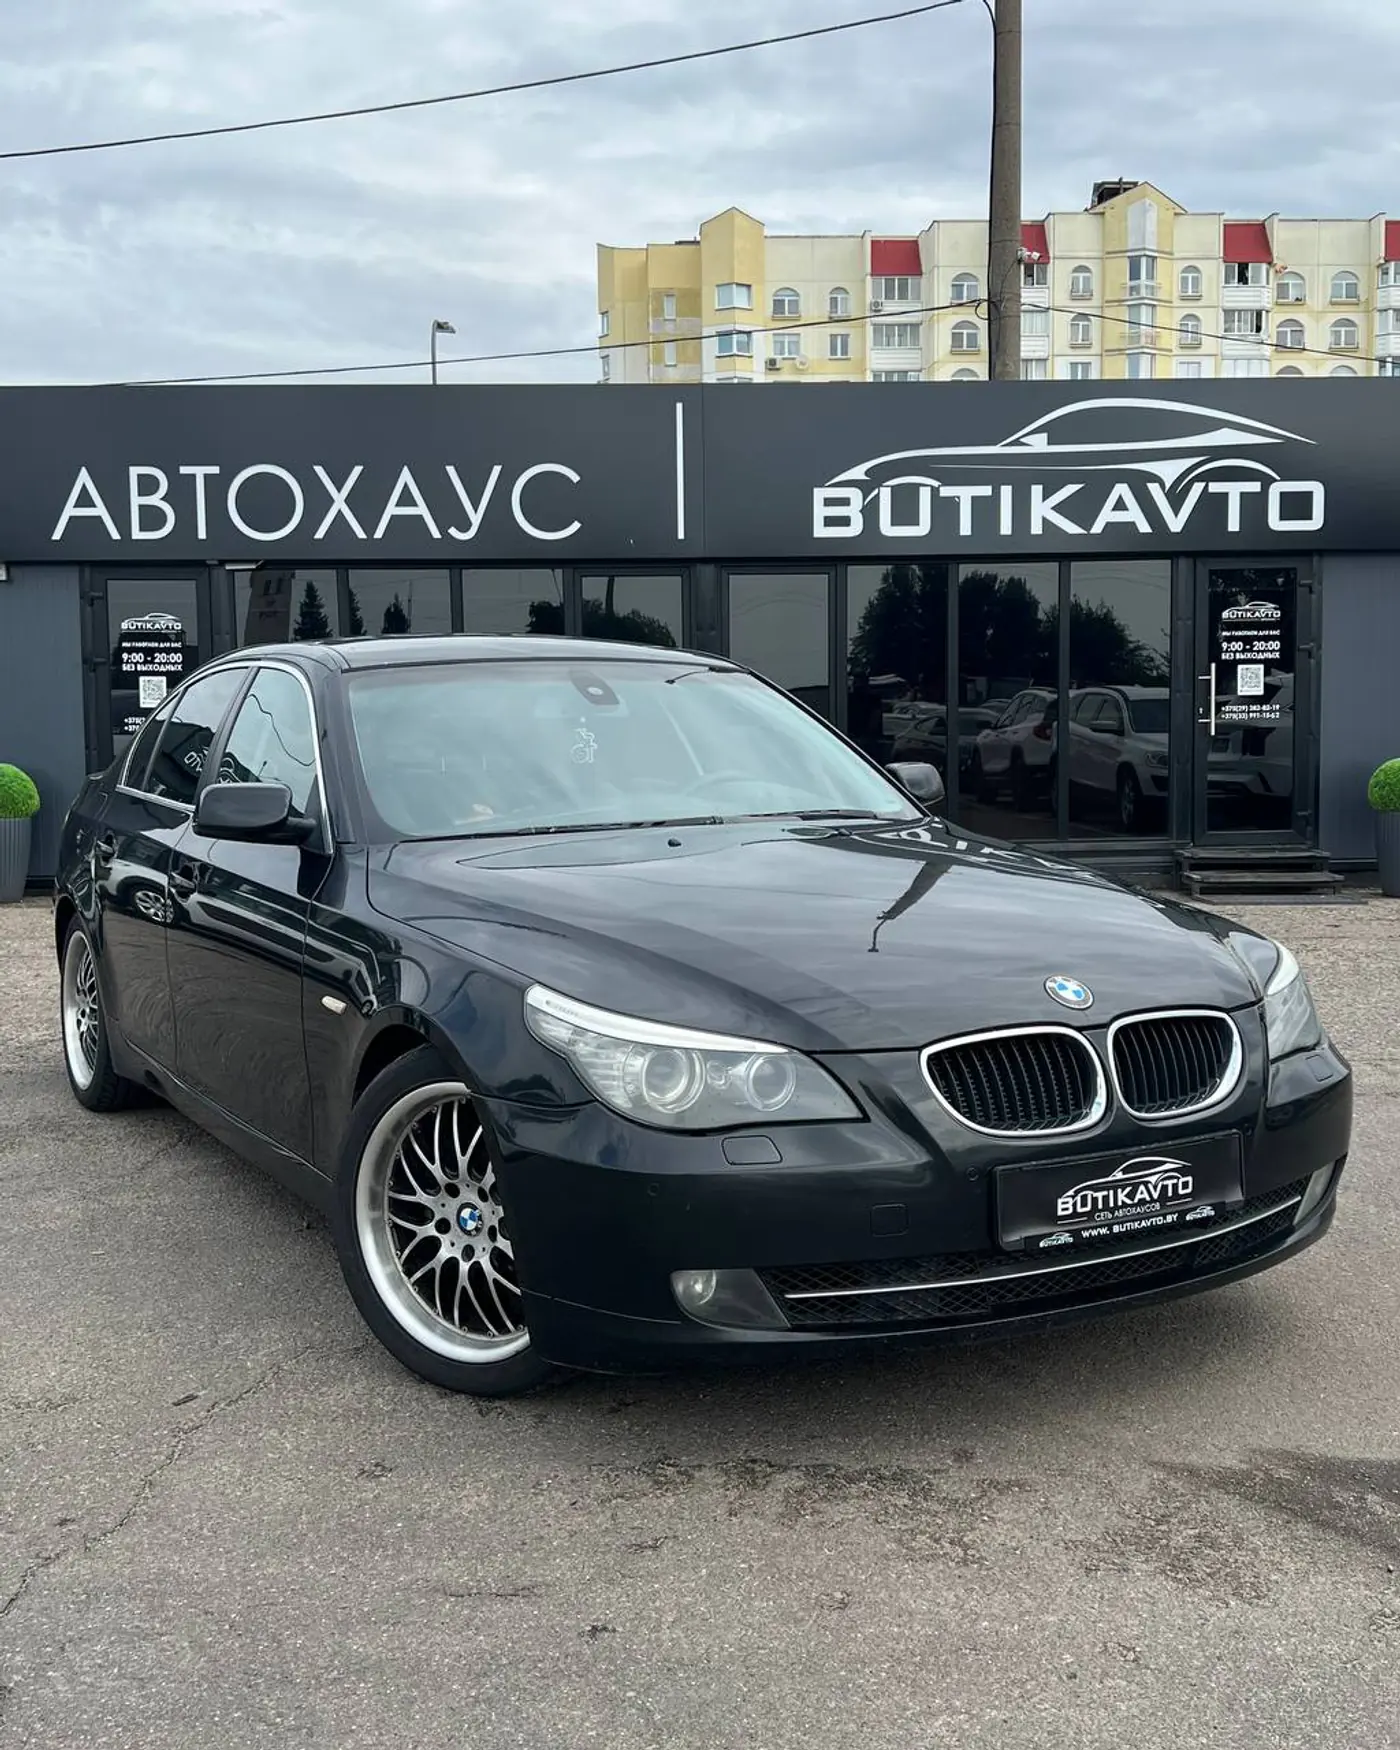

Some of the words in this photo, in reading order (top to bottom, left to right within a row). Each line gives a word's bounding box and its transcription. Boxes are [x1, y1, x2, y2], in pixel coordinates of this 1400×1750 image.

[51, 463, 583, 542] АВТОХАУС
[812, 481, 1326, 538] BUTIKAVTO
[1221, 610, 1281, 619] BUTIKAVTO
[121, 621, 182, 630] BUTIKAVTO
[1221, 641, 1244, 652] 9:00
[1252, 640, 1281, 651] 20:00
[121, 652, 144, 663] 9:00
[154, 652, 183, 663] 20:00
[1221, 652, 1234, 660] БЕЗ
[1235, 651, 1281, 660] ВЫХОДНЫХ
[122, 663, 135, 671] БЕЗ
[137, 663, 183, 672] ВЫХОДНЫХ
[1057, 1176, 1193, 1216] BUTIKAVTO
[1094, 1211, 1113, 1221] СЕТЬ
[1114, 1202, 1161, 1218] АВТОХАУСОВ
[1112, 1213, 1179, 1233] BUTIKAVTO.BY
